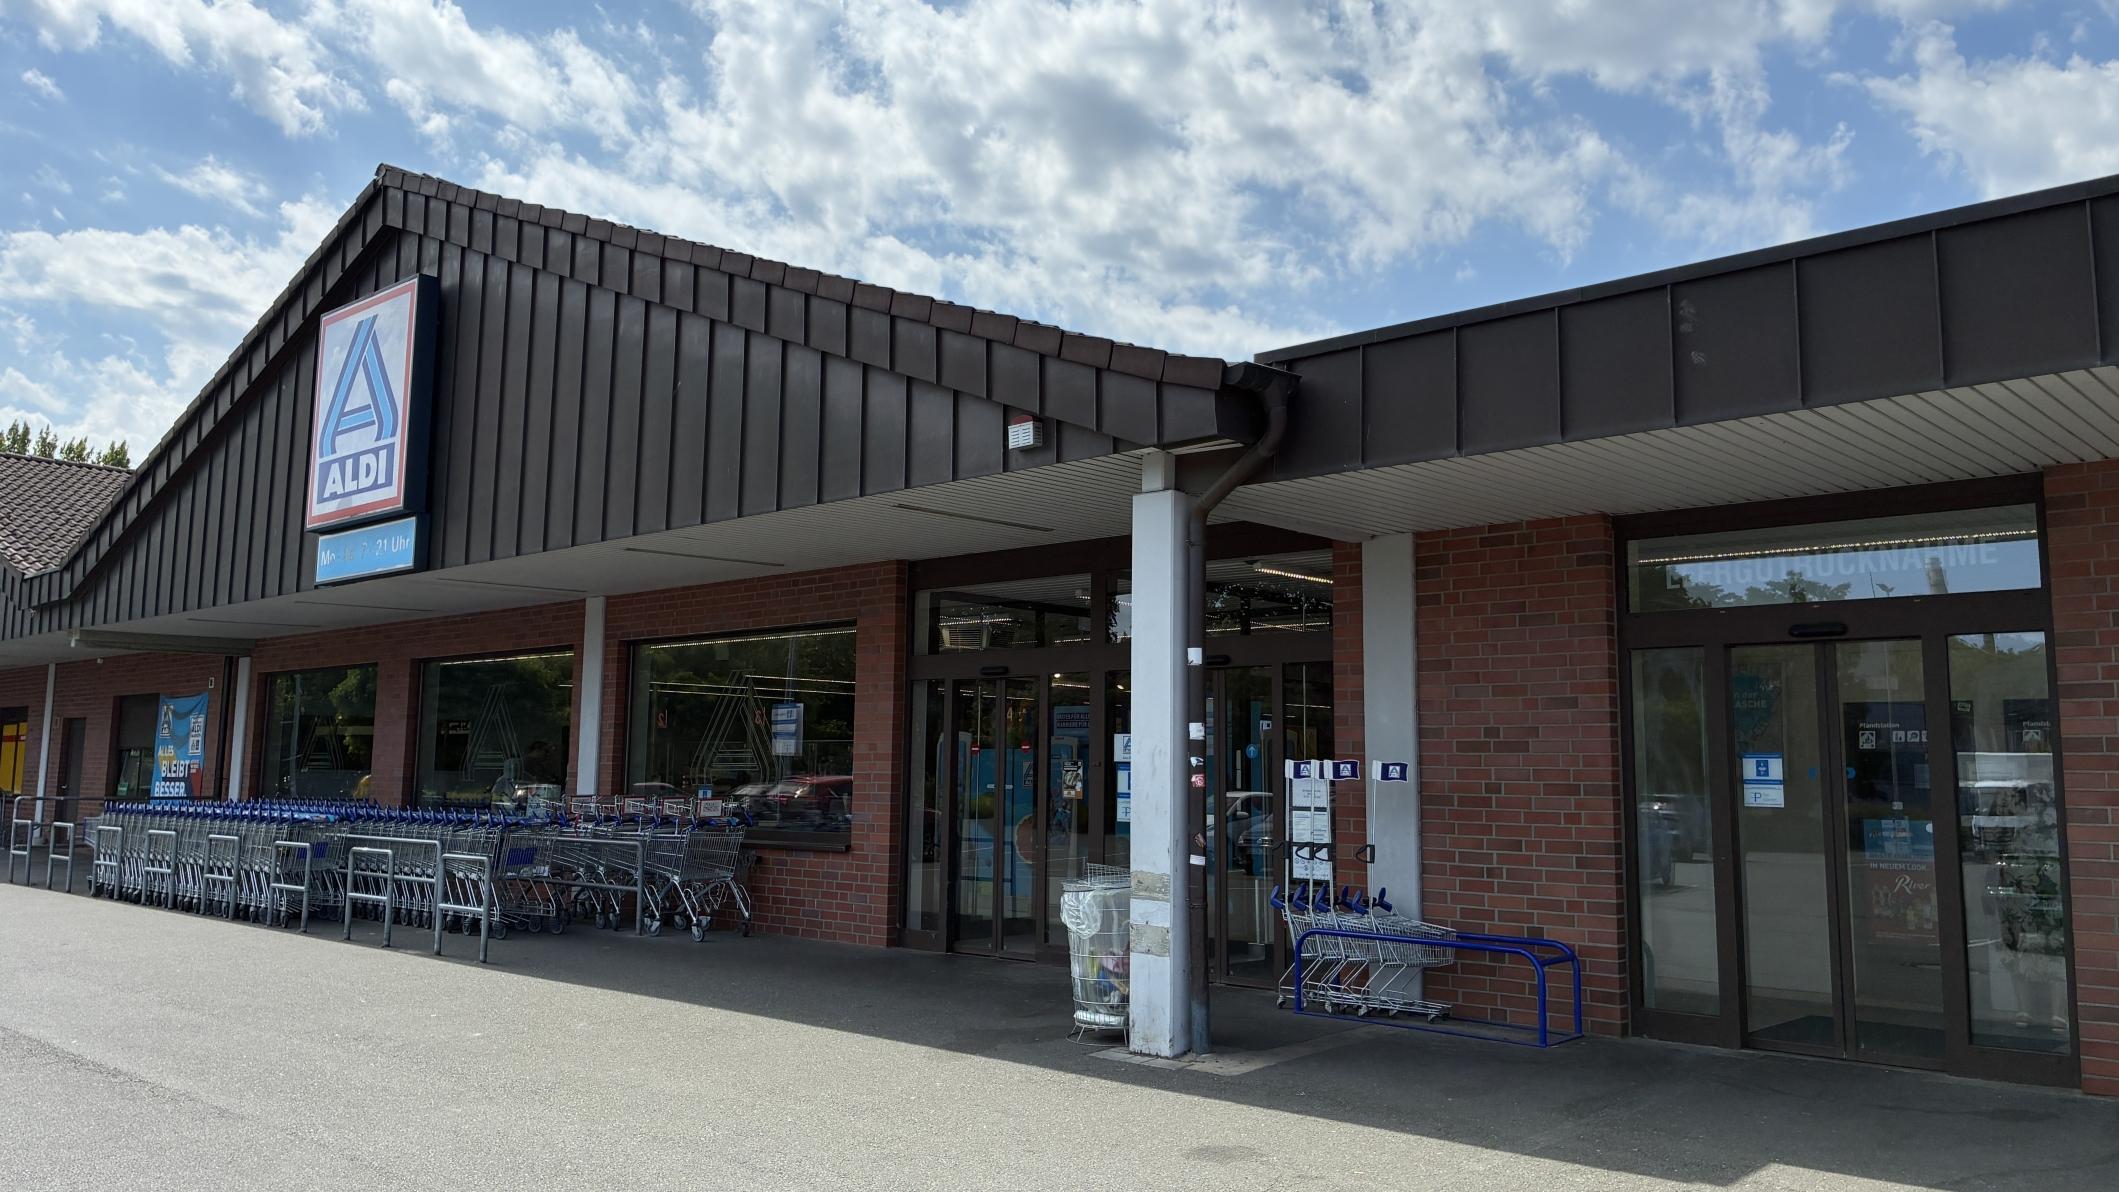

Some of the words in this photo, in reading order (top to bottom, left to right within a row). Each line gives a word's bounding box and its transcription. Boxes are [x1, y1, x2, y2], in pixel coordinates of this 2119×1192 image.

[323, 449, 387, 498] ALDI
[391, 535, 410, 553] Uhr
[158, 744, 174, 757] ALLES
[161, 759, 190, 778] BLEIBT
[154, 781, 187, 797] BESSER.
